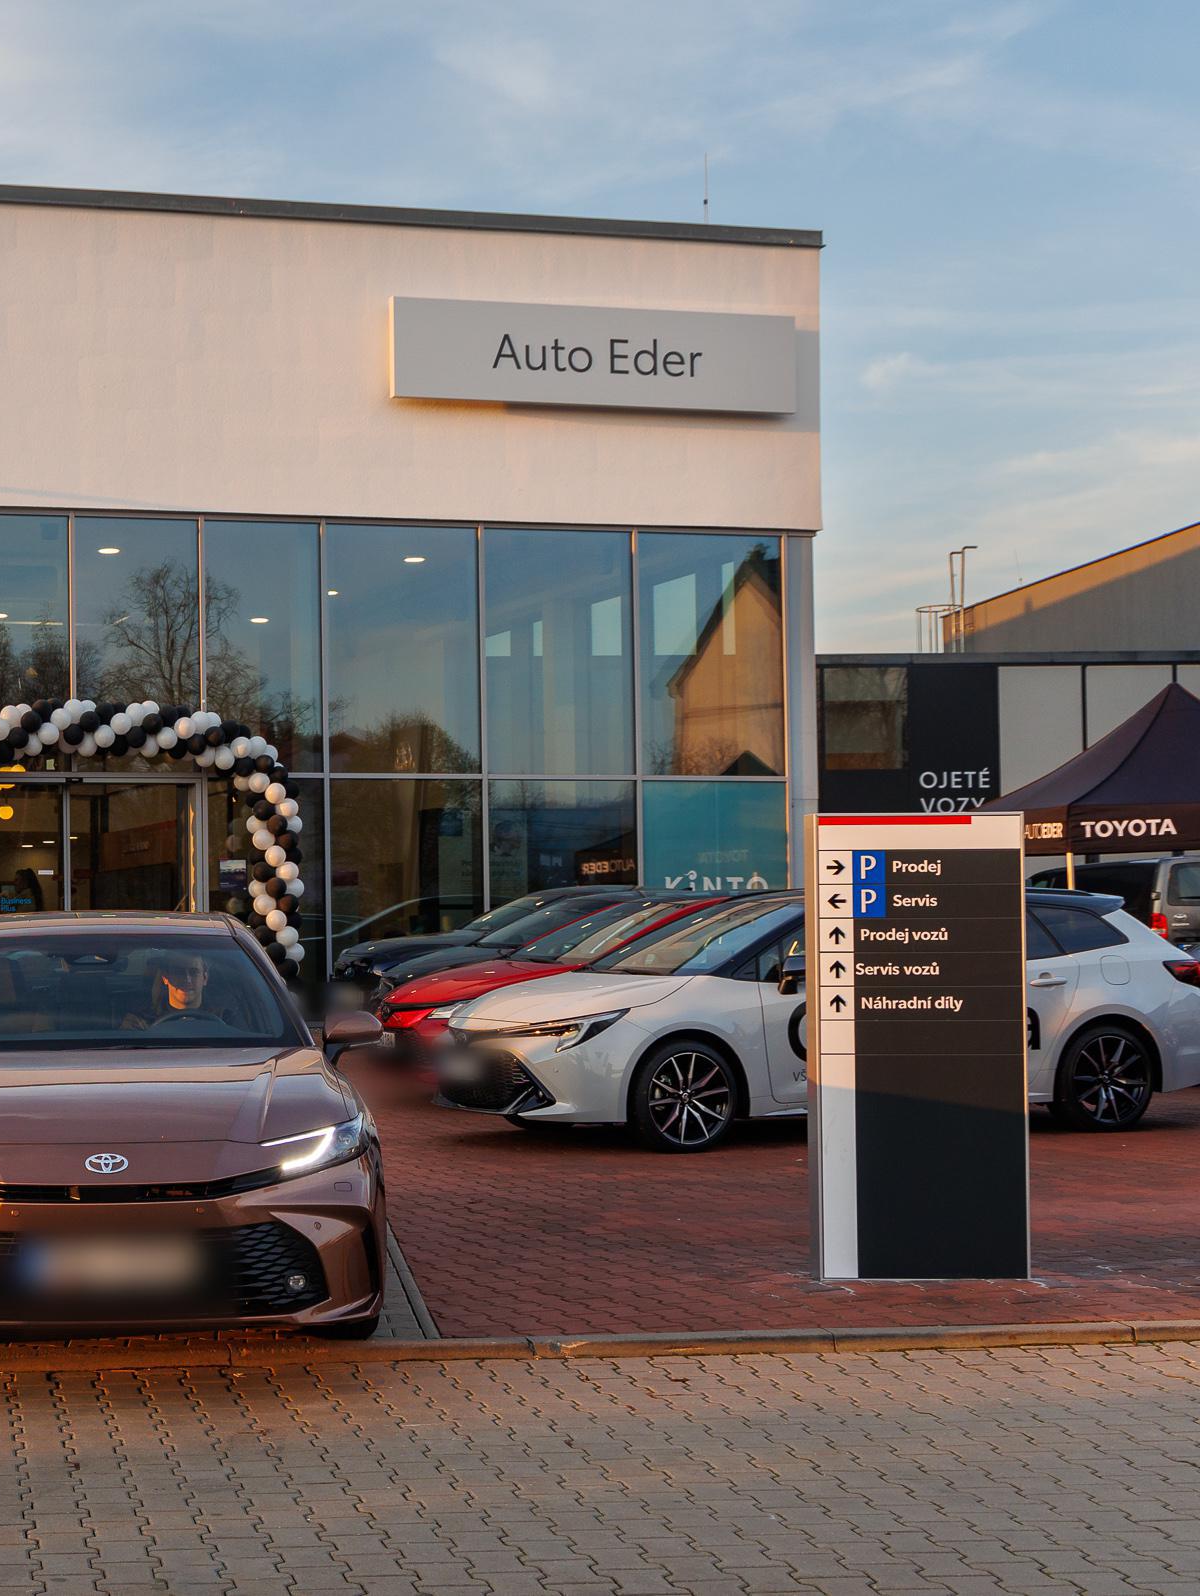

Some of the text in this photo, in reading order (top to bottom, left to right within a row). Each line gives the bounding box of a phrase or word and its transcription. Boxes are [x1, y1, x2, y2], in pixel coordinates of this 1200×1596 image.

[493, 334, 703, 377] Auto Eder
[919, 767, 991, 789] OJETÉ
[1080, 818, 1178, 838] TOYOTA
[860, 855, 942, 880] P Prodej
[860, 889, 938, 914] P Servis
[860, 927, 949, 944] Prodej vozů
[855, 961, 940, 976] Servis vozů
[860, 995, 964, 1012] Náhradní díly
